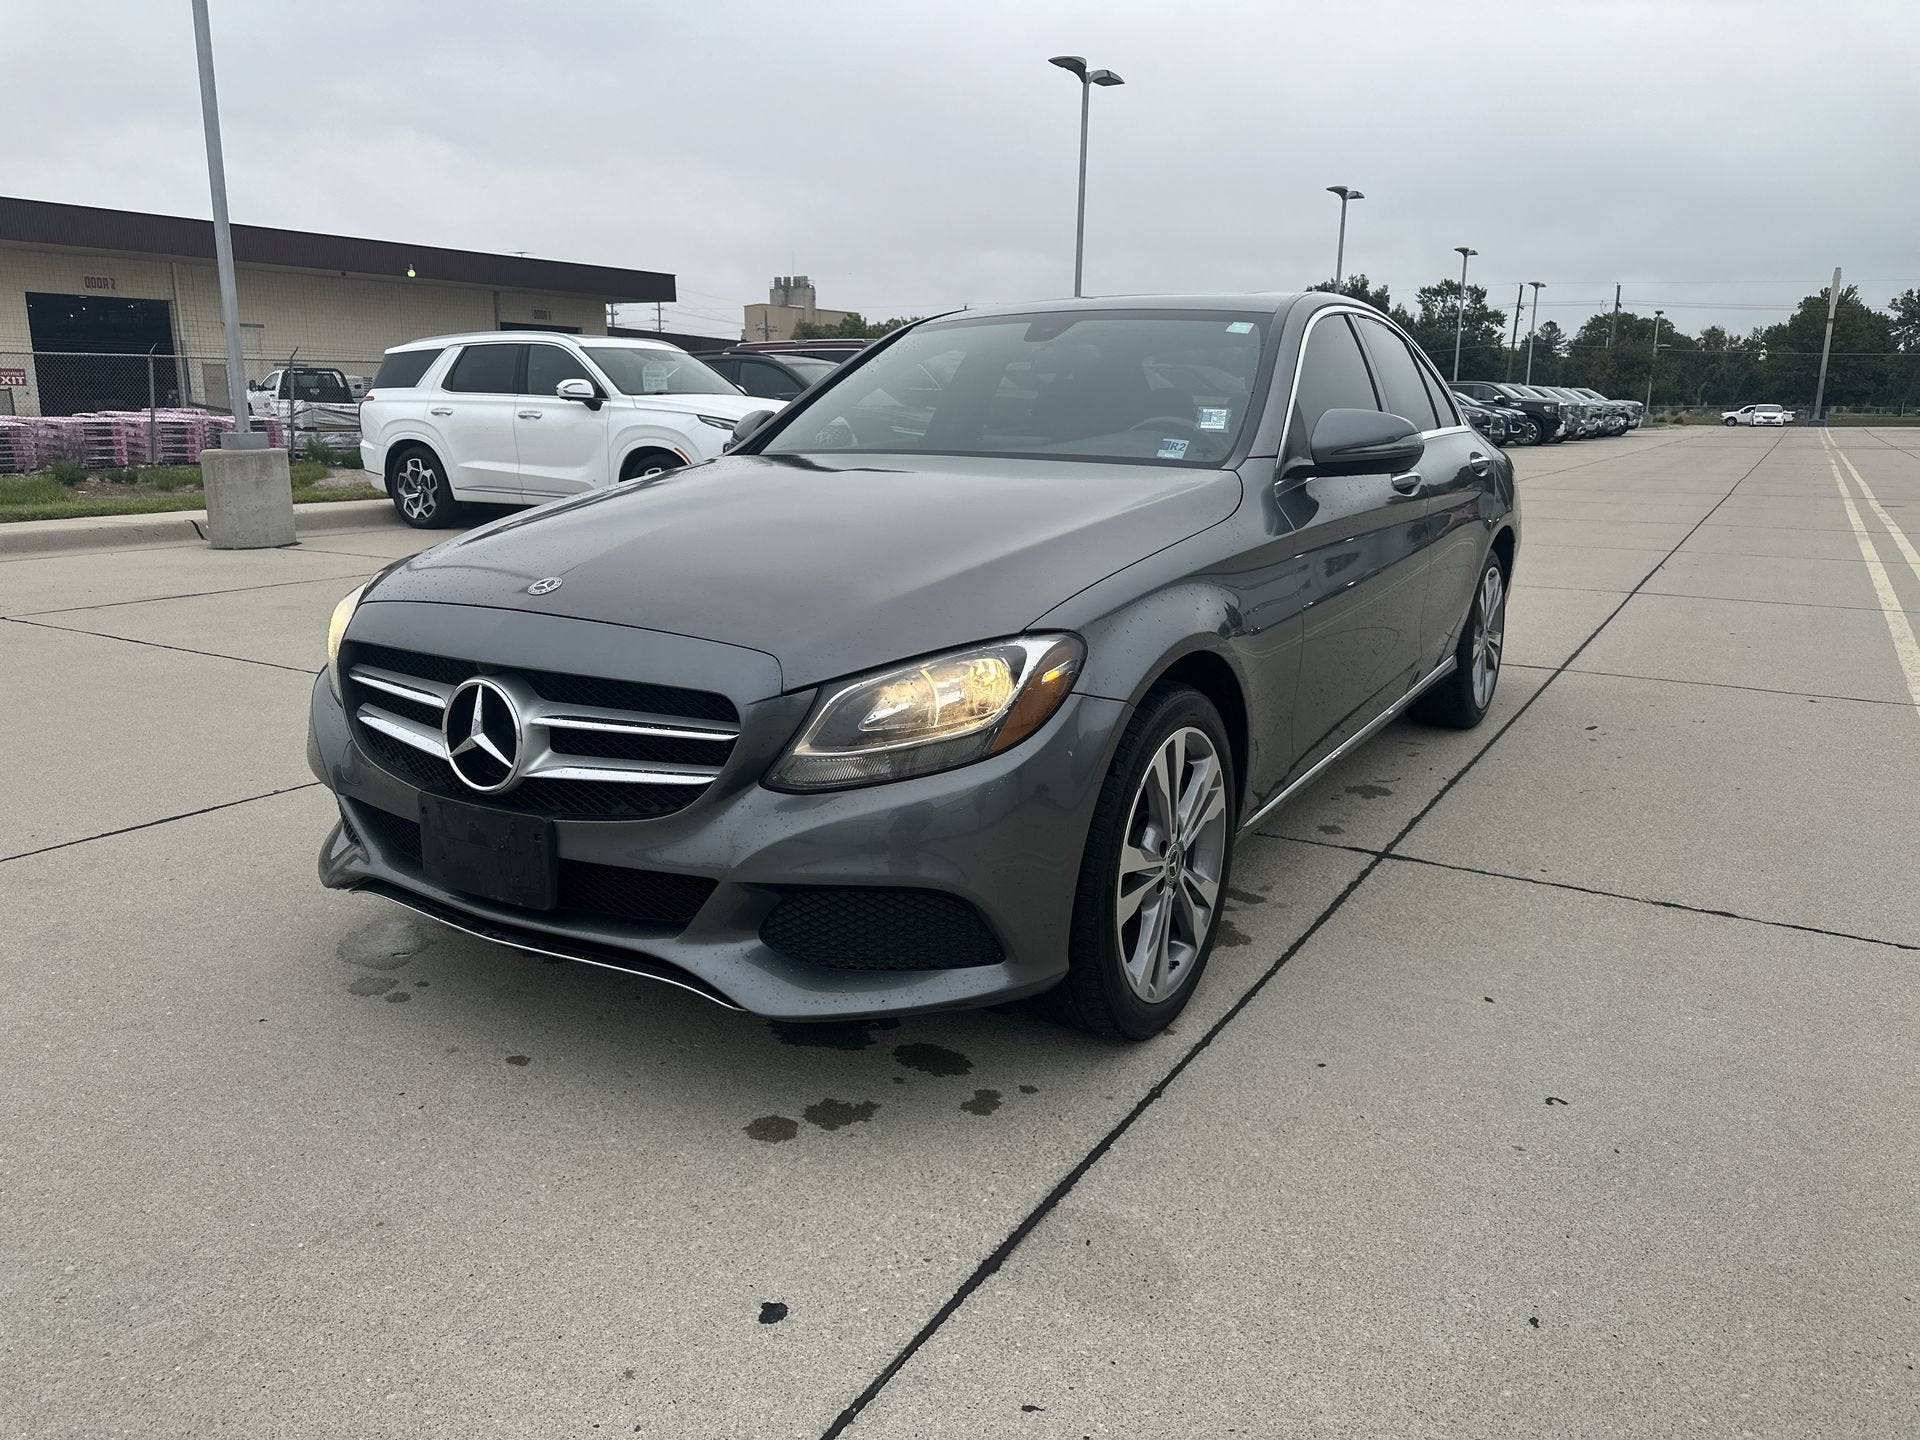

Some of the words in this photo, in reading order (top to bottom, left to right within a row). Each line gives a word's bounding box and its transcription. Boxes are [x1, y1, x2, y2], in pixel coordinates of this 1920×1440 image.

[84, 276, 109, 289] DOOR
[110, 278, 116, 290] 2
[0, 376, 24, 385] XIT
